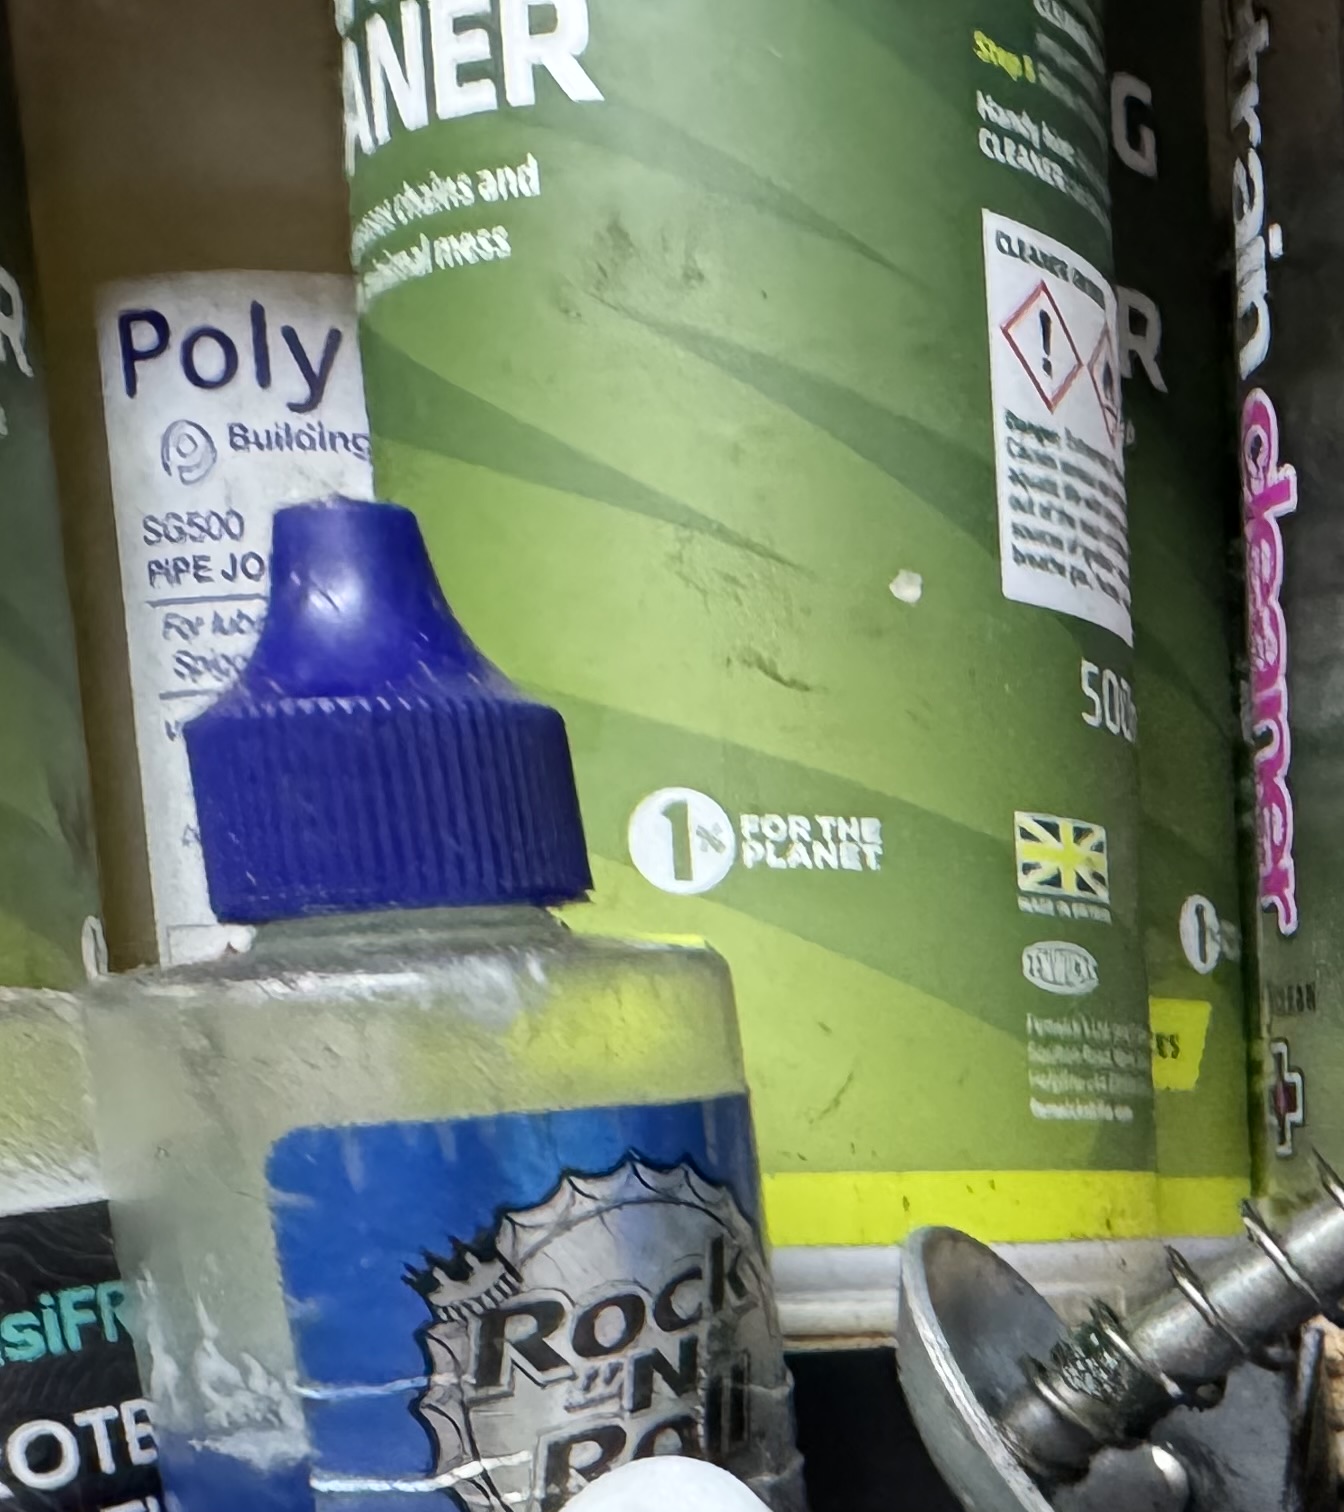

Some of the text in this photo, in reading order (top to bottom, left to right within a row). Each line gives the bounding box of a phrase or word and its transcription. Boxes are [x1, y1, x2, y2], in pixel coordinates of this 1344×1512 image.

[476, 152, 541, 202] and
[433, 225, 512, 270] mess
[117, 300, 343, 414] Poly
[141, 507, 245, 546] SG500
[146, 553, 215, 590] PIPE
[740, 813, 813, 843] FOR
[741, 840, 884, 872] PLANET
